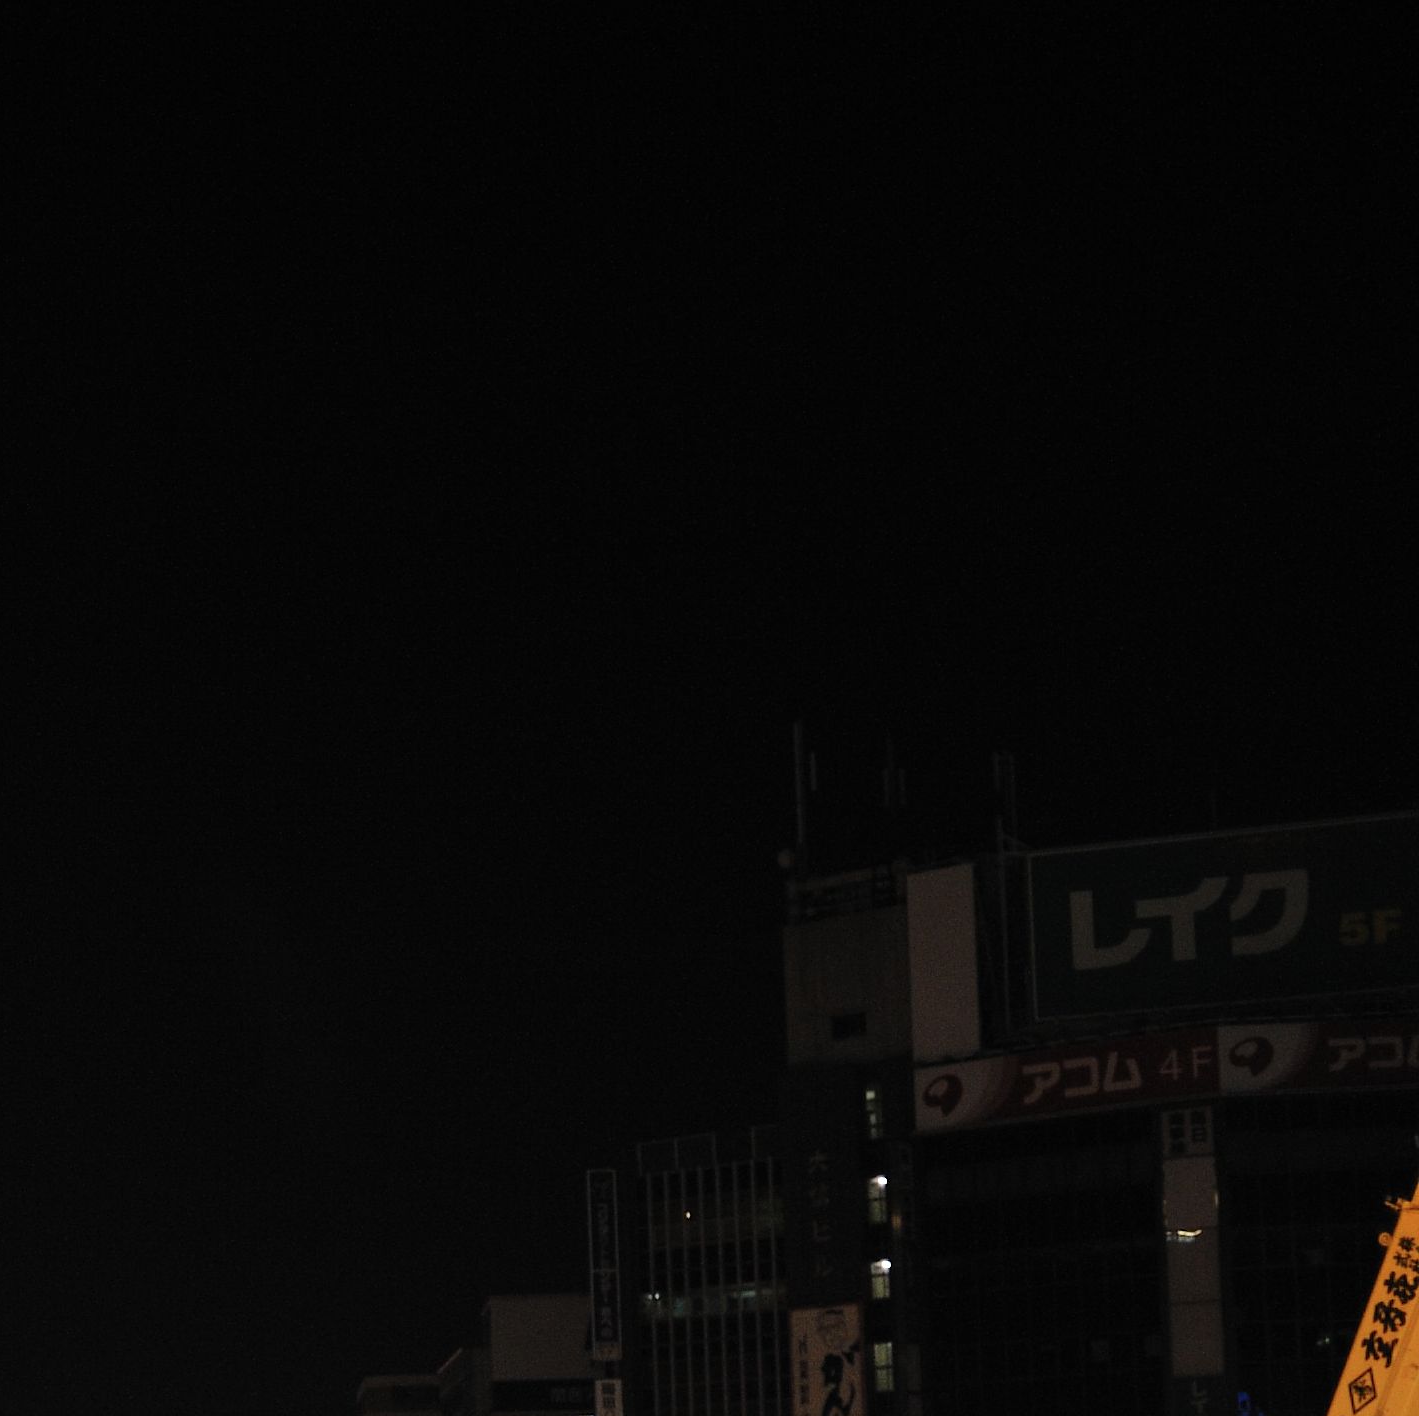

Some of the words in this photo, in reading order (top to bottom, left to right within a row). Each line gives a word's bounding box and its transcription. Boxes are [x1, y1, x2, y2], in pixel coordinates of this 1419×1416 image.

[1067, 868, 1309, 971] レイク
[1021, 1050, 1144, 1107] アコム
